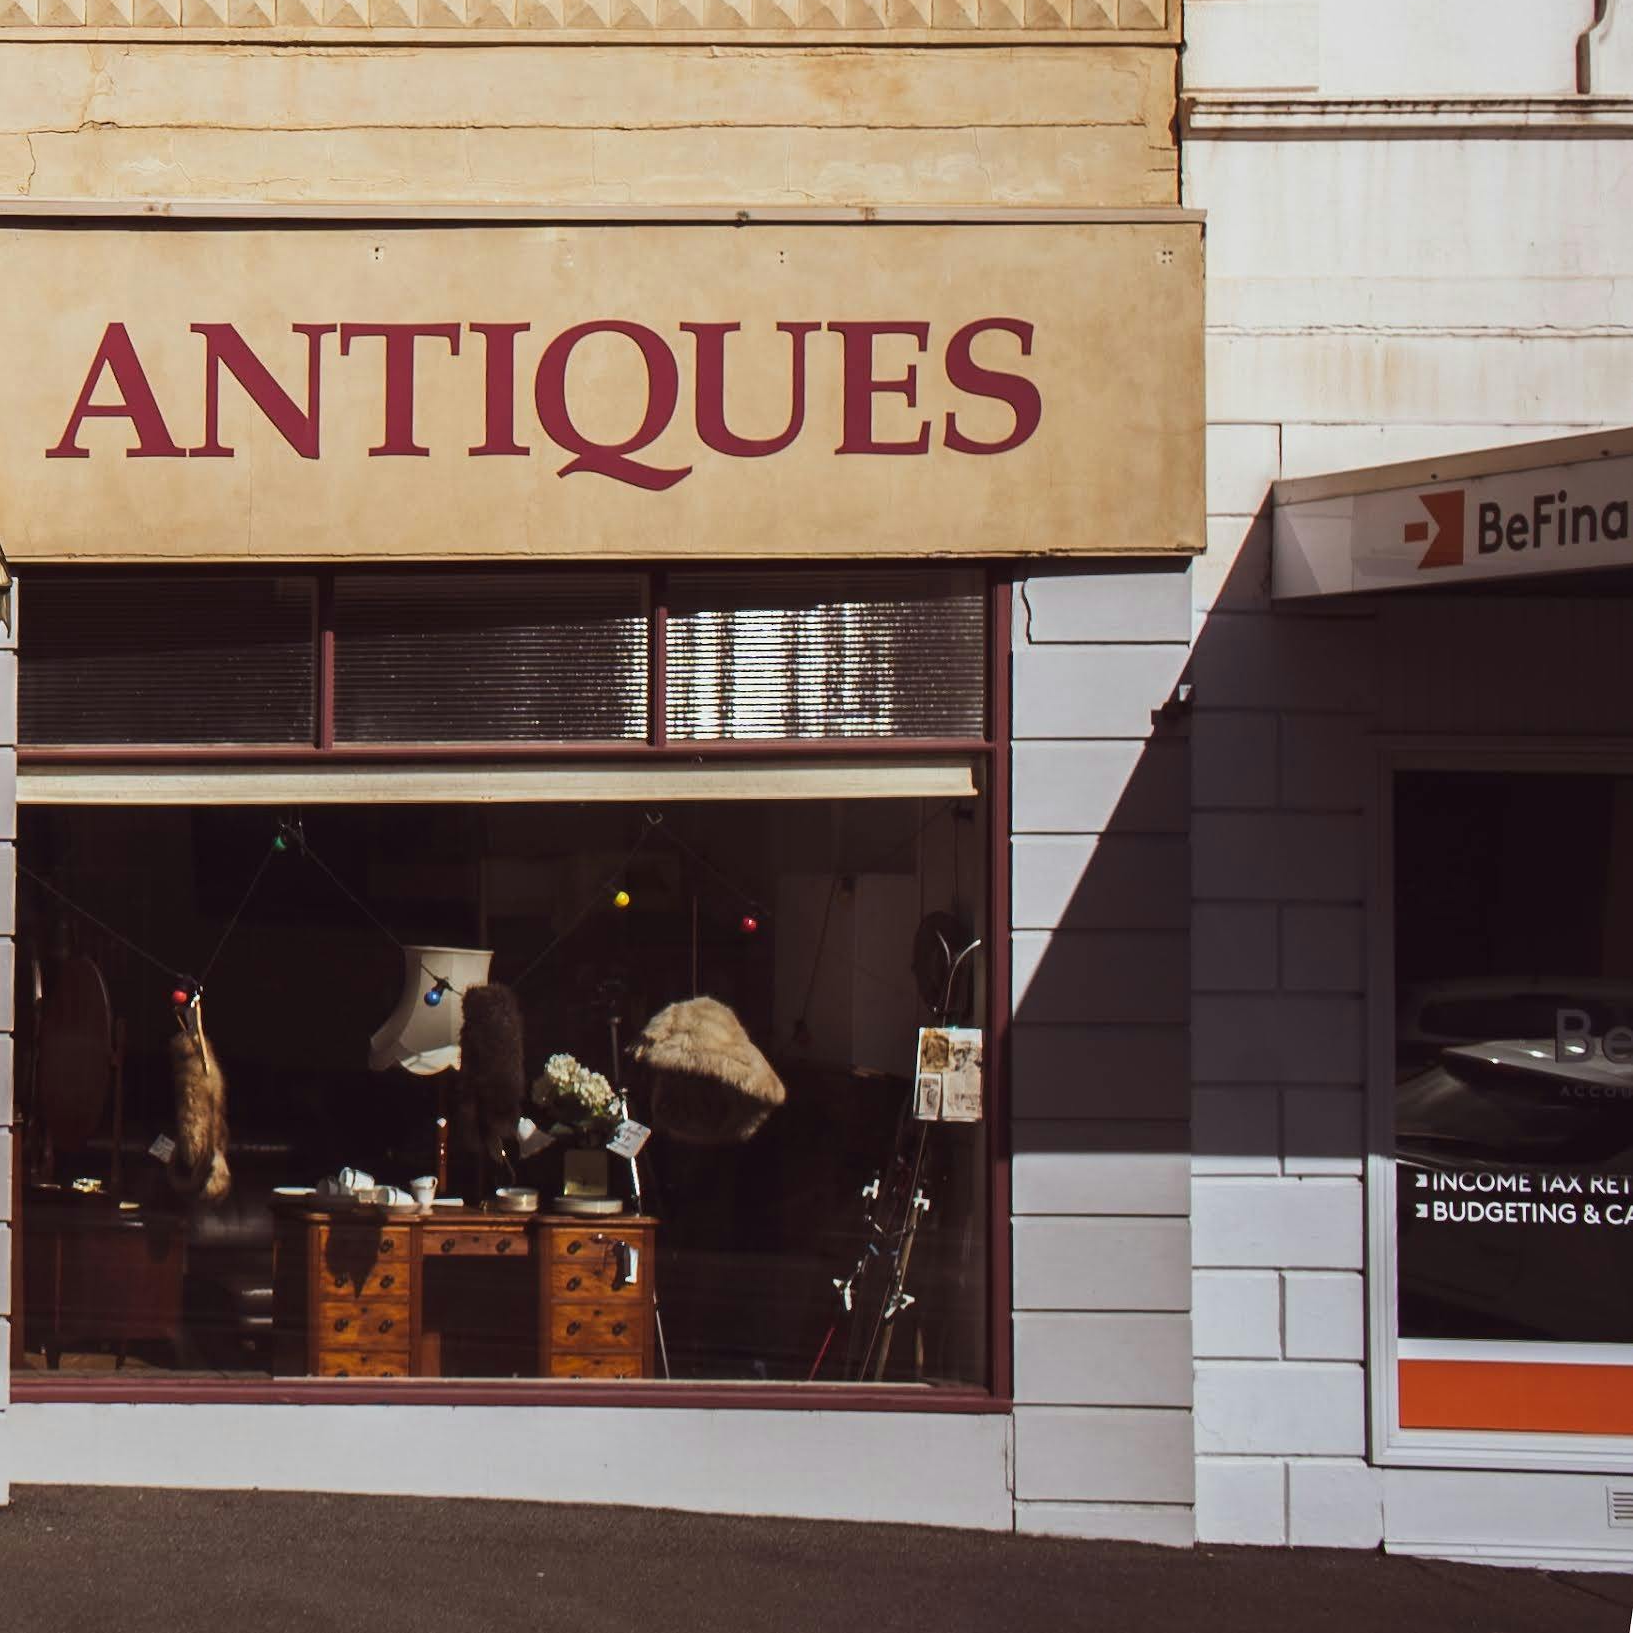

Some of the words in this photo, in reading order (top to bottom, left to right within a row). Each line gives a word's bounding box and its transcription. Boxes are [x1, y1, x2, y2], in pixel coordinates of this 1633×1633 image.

[44, 317, 1043, 492] ANTIQUES
[1477, 489, 1630, 555] BeFina
[1432, 1172, 1532, 1193] INCOME
[1539, 1173, 1584, 1195] TAX
[1432, 1200, 1577, 1225] BUDGETING
[1583, 1203, 1602, 1225] &
